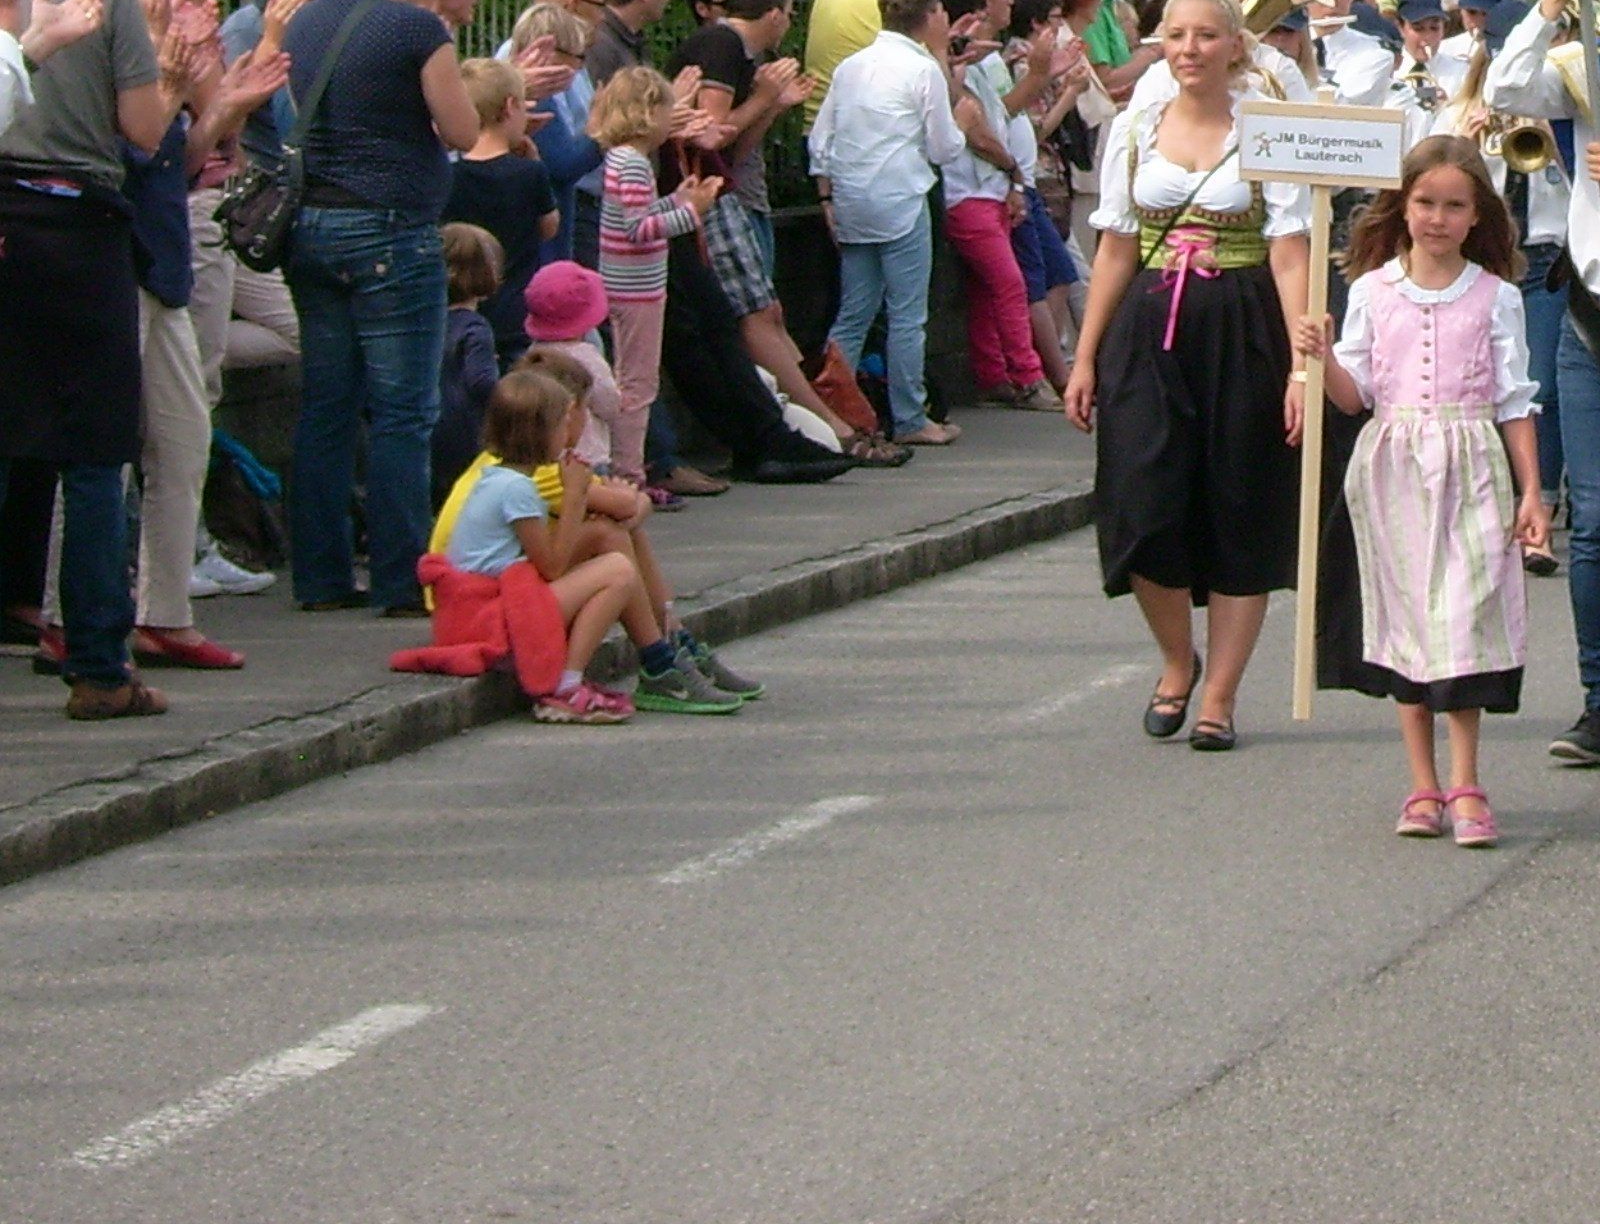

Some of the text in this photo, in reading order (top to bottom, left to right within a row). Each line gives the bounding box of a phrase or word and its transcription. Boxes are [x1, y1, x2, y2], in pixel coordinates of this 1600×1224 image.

[1276, 132, 1384, 150] JM Bürgermusik
[1294, 148, 1363, 163] Lauterach
